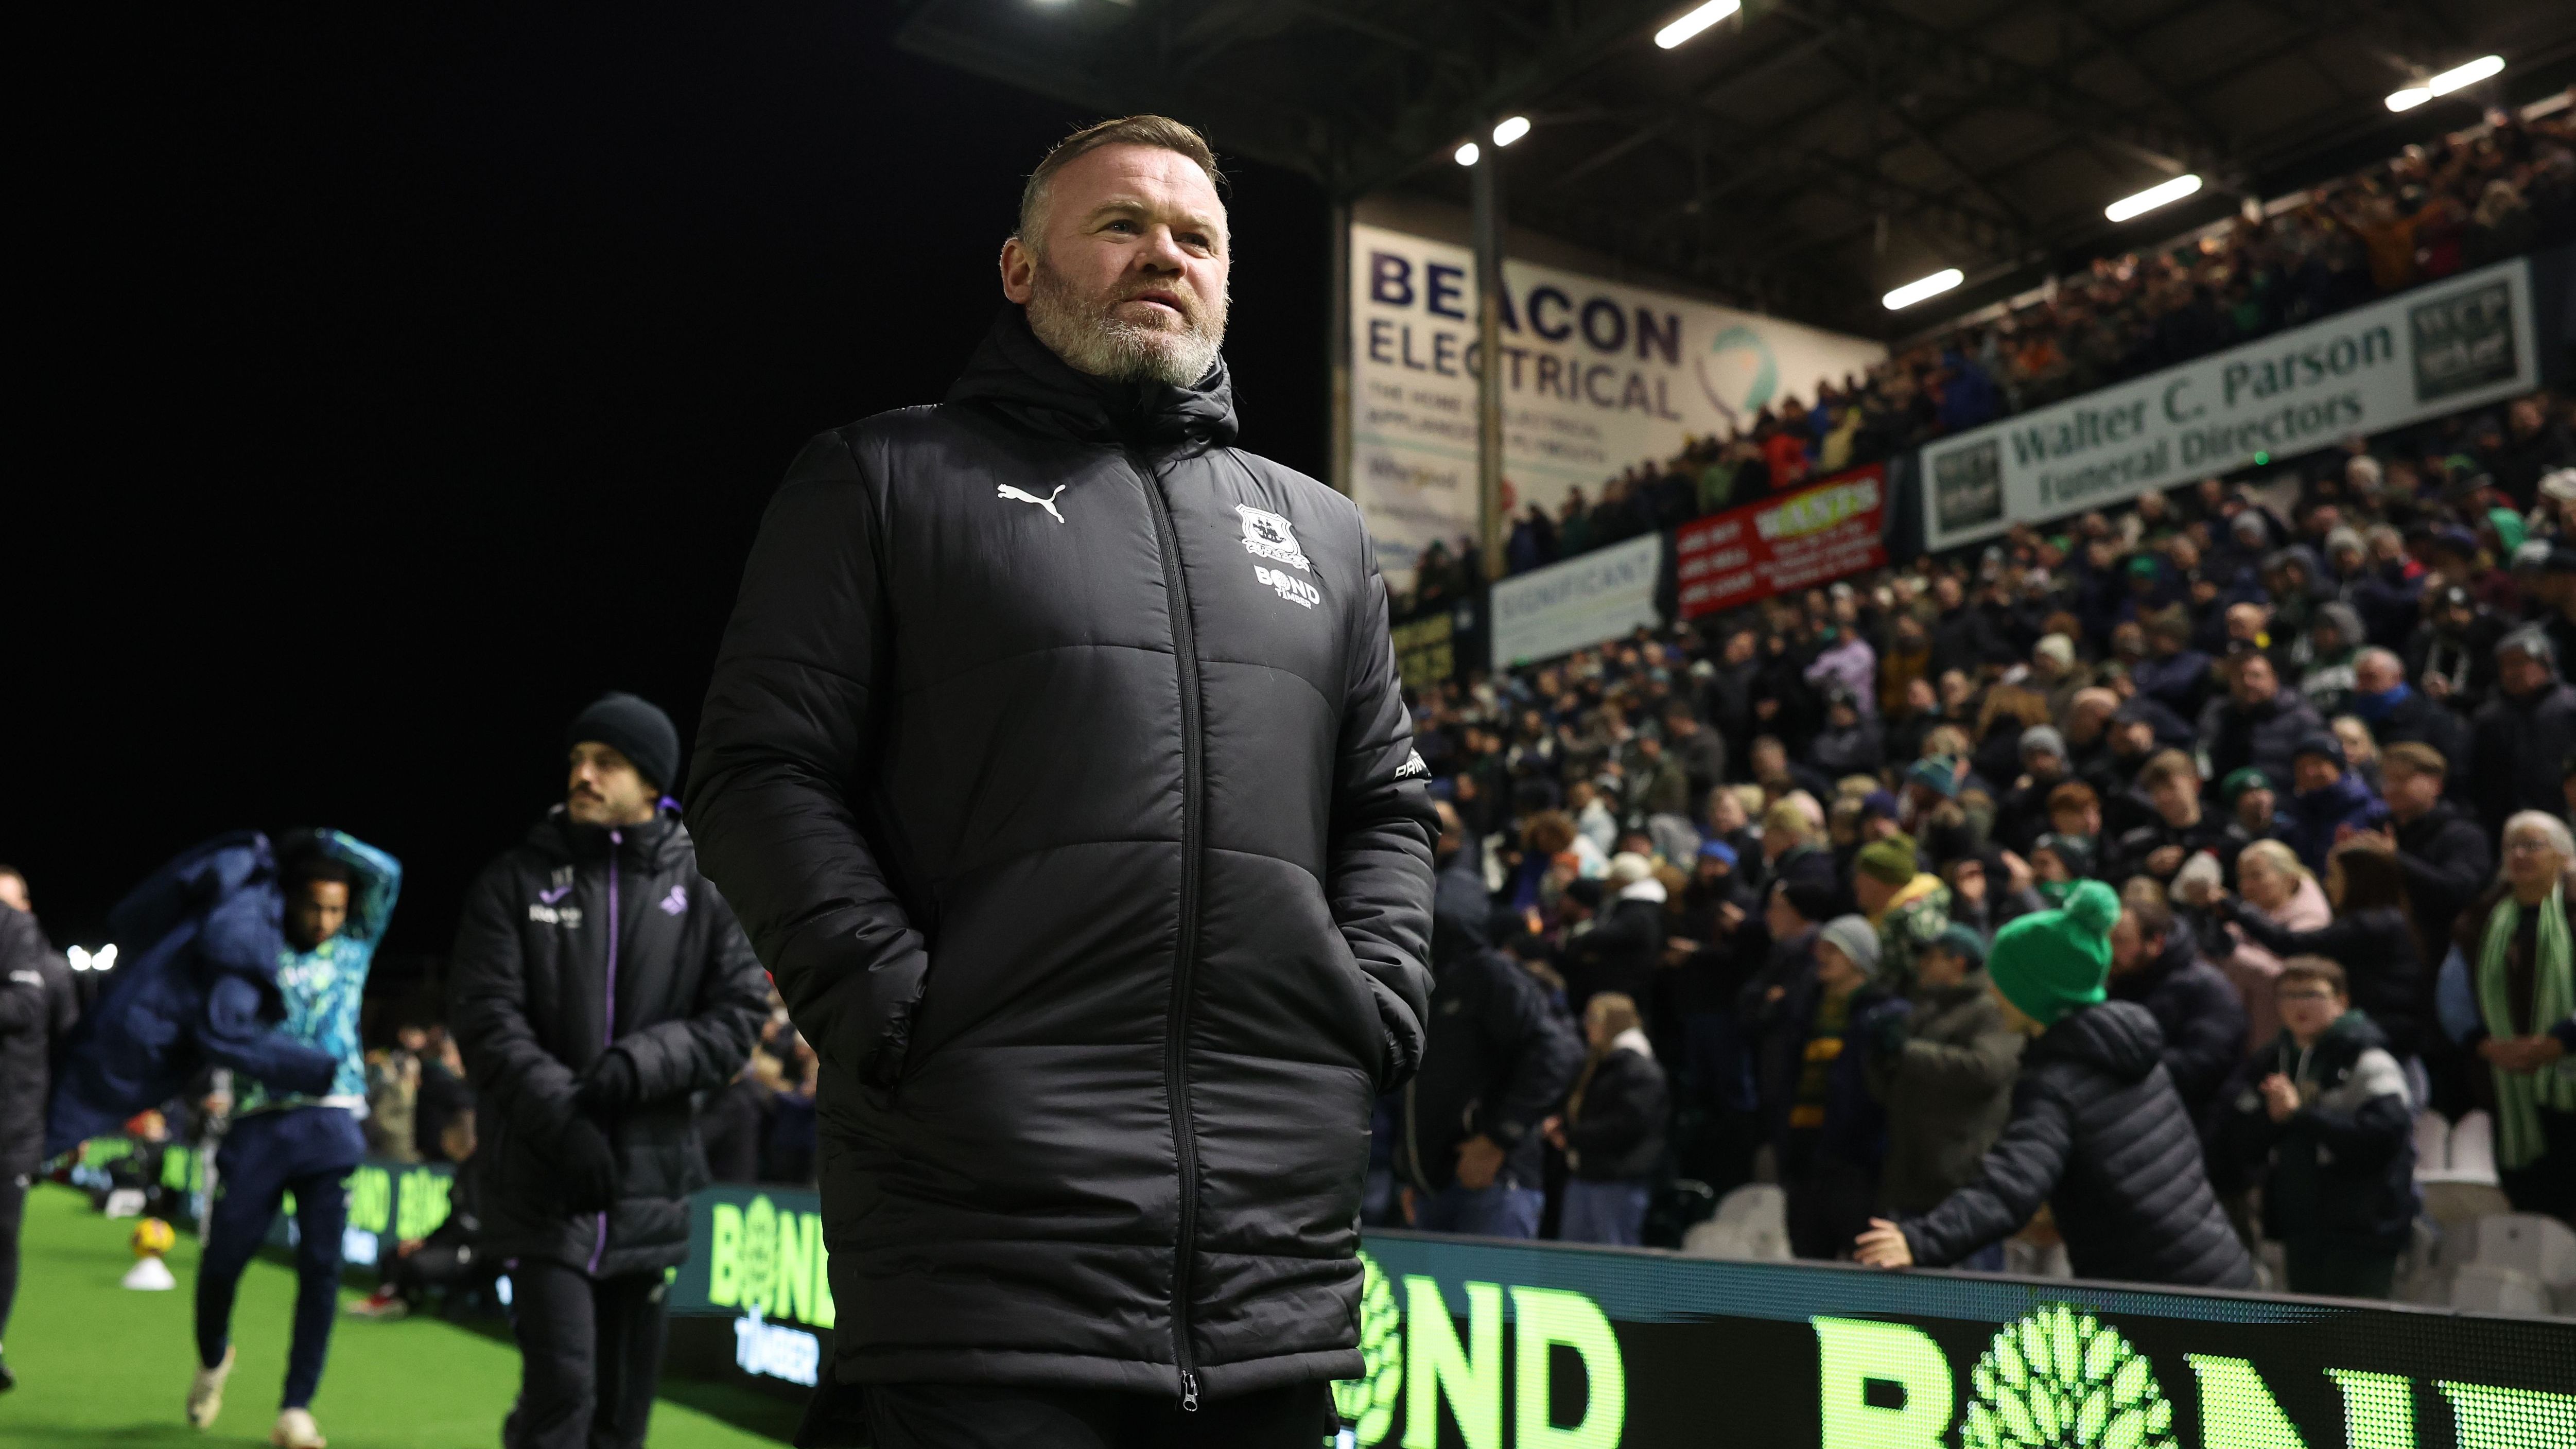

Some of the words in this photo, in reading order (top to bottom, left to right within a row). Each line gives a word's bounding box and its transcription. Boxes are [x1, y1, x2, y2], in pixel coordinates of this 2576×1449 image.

[2010, 398, 2147, 466] Walter
[2163, 377, 2205, 424] C.
[2222, 324, 2393, 407] Parson
[2037, 439, 2168, 505] Funeral
[2181, 390, 2363, 465] Directors
[1254, 565, 1320, 605] BOND
[1275, 587, 1312, 609] TIMBER
